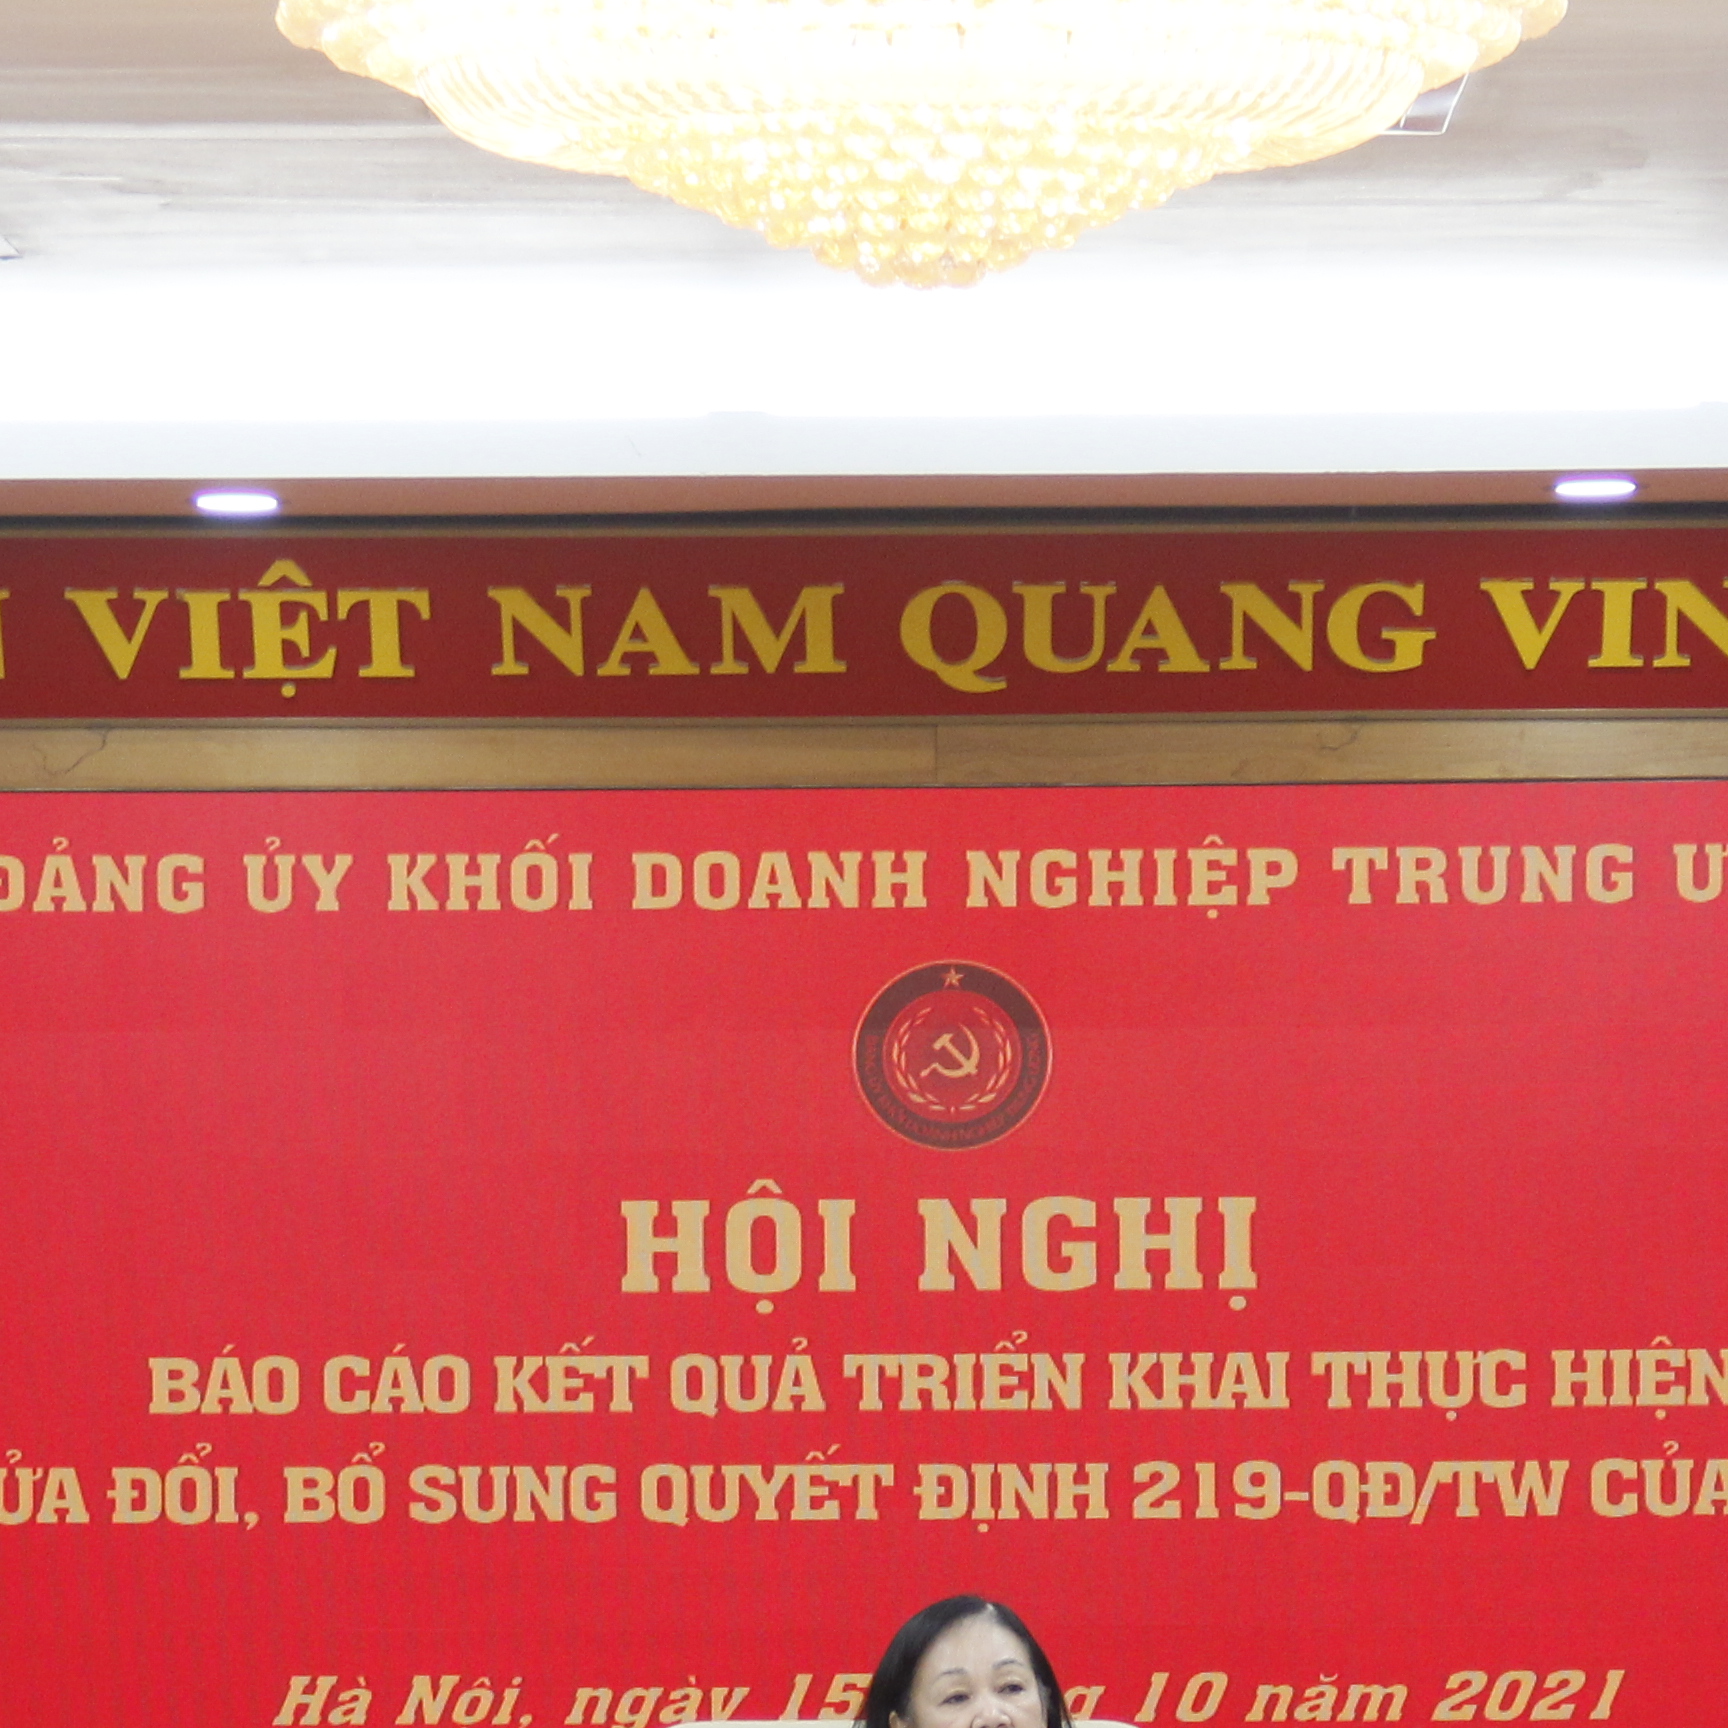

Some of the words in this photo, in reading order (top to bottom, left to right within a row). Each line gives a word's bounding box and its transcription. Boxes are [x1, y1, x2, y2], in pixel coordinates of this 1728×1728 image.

[64, 558, 432, 699] VIỆT
[486, 582, 848, 678] NAM
[899, 580, 1438, 694] QUANG
[242, 835, 354, 914] ỦY
[386, 832, 593, 913] KHỐI
[631, 849, 928, 911] DOANH
[965, 834, 1299, 919] NGHIỆP
[1331, 842, 1634, 906] TRUNG
[620, 1178, 857, 1315] HỘI
[917, 1195, 1258, 1311] NGHỊ
[148, 1344, 300, 1415] BÁO
[323, 1343, 471, 1415] CÁO
[493, 1335, 650, 1413] KẾT
[670, 1336, 826, 1418] QUẢ
[842, 1330, 1086, 1411] TRIỂN
[1108, 1351, 1290, 1410] KHAI
[1310, 1348, 1527, 1422] THỰC
[106, 1442, 259, 1530] ĐỔI,
[283, 1441, 386, 1525] BỔ
[409, 1463, 617, 1524] SUNG
[640, 1443, 895, 1527] QUYẾT
[913, 1462, 1110, 1533] ĐỊNH
[1132, 1459, 1570, 1525] 219-QĐ/TW
[272, 1675, 372, 1726] Hà
[1134, 1671, 1229, 1722] 10
[1245, 1673, 1408, 1722] năm
[1431, 1669, 1626, 1722] 2021
